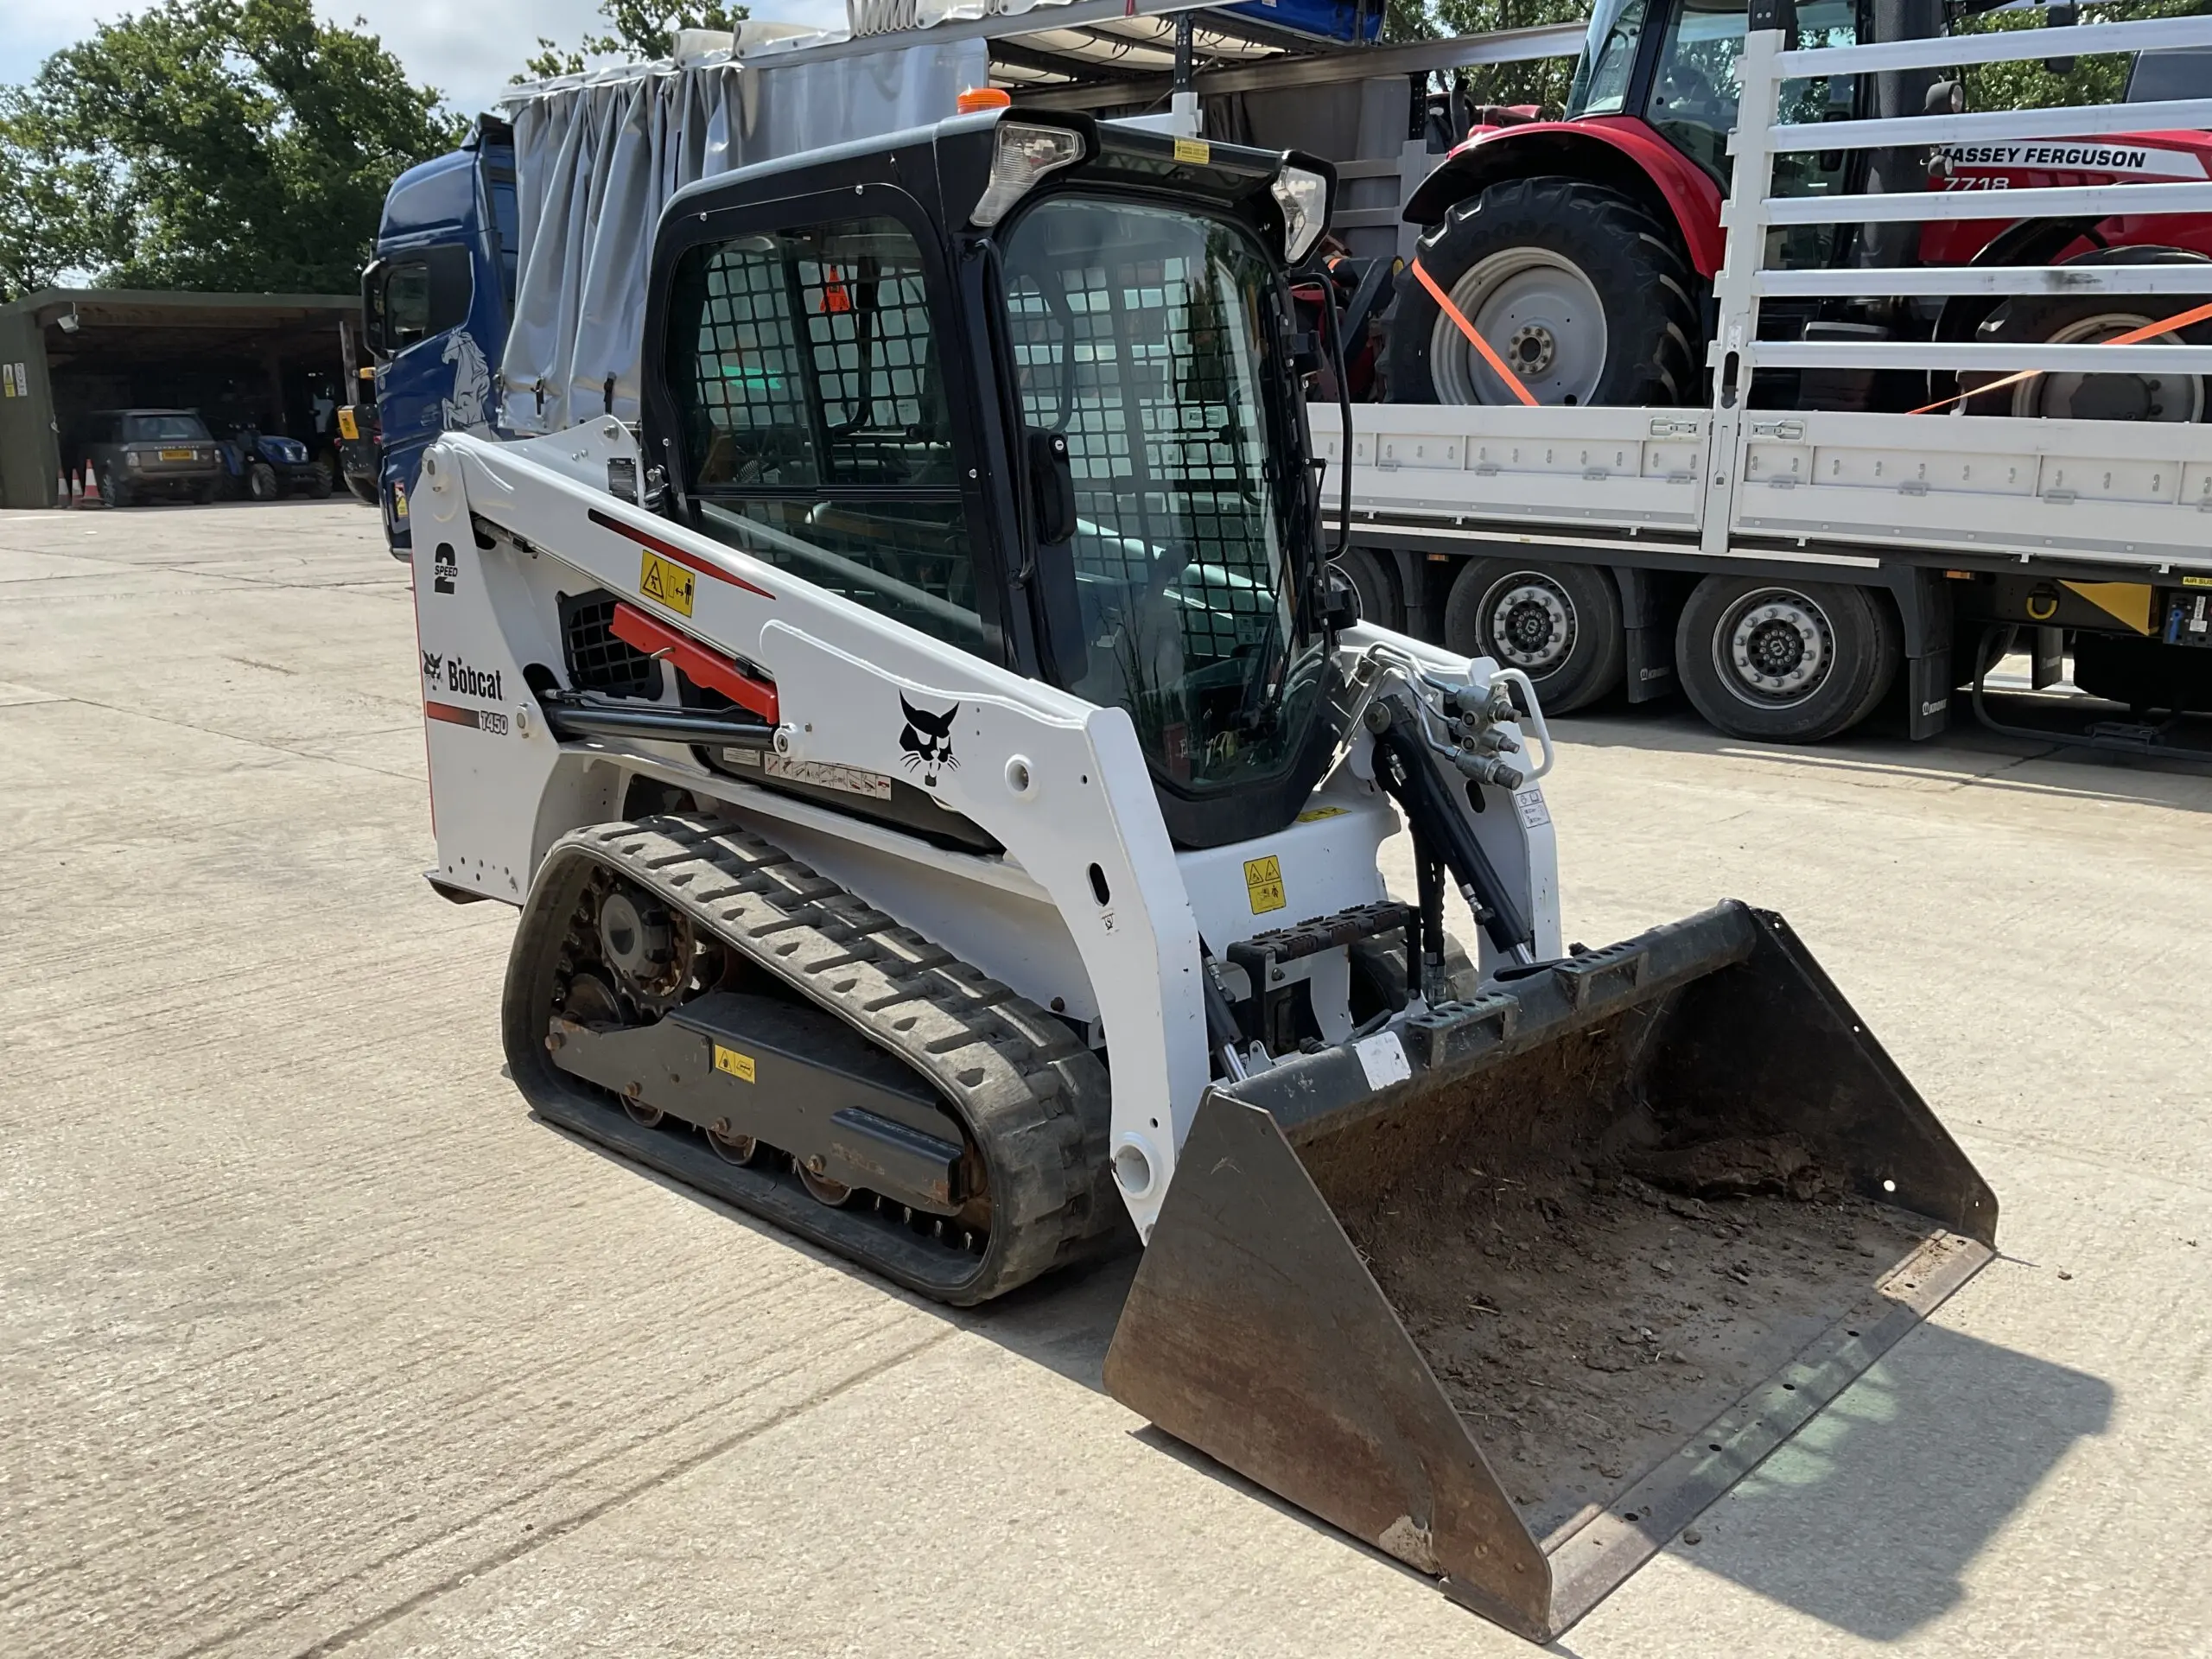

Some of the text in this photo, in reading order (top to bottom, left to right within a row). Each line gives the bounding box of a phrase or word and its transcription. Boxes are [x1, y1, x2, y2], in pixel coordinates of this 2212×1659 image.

[2024, 147, 2146, 168] FERGUSON
[1944, 177, 2010, 191] 7718
[434, 564, 458, 577] SPEED
[448, 659, 503, 701] Bobcat
[480, 710, 509, 735] T450
